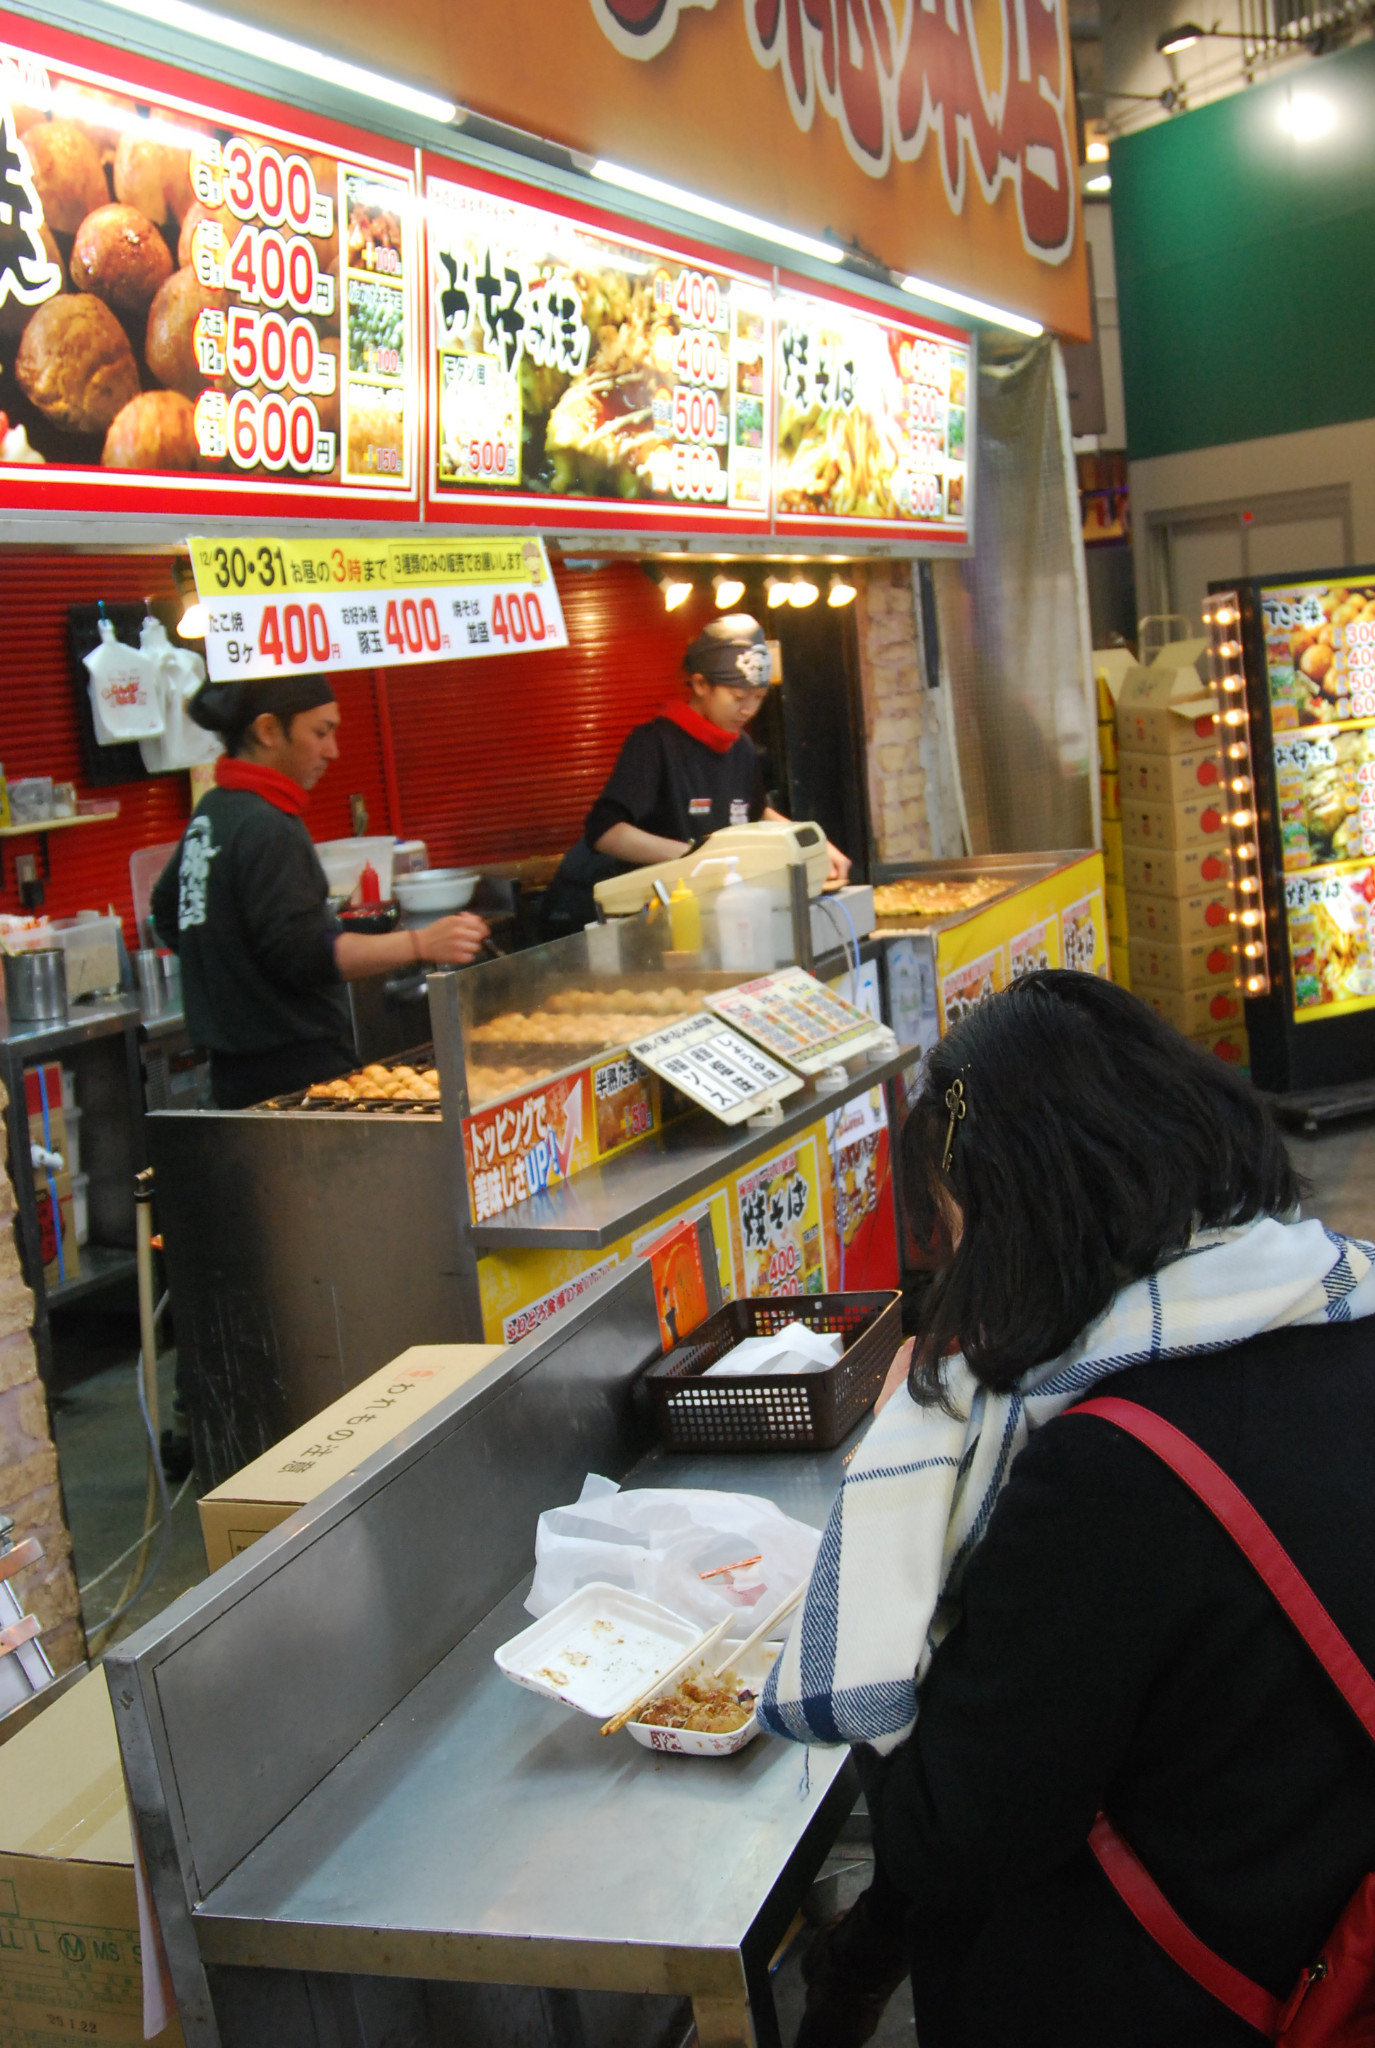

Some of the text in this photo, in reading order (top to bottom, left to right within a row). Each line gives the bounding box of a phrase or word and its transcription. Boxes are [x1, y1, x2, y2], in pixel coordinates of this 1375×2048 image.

[233, 398, 330, 465] 600円
[290, 549, 387, 584] お昼の3時まで
[257, 602, 342, 666] 400円
[340, 604, 379, 625] お好み焼
[384, 597, 451, 655] 400円
[491, 591, 558, 645] 400円
[471, 1095, 548, 1168] トッピングで
[743, 1177, 807, 1247] 焼そば
[277, 1382, 416, 1475] われもの注意
[93, 1940, 120, 1962] MS
